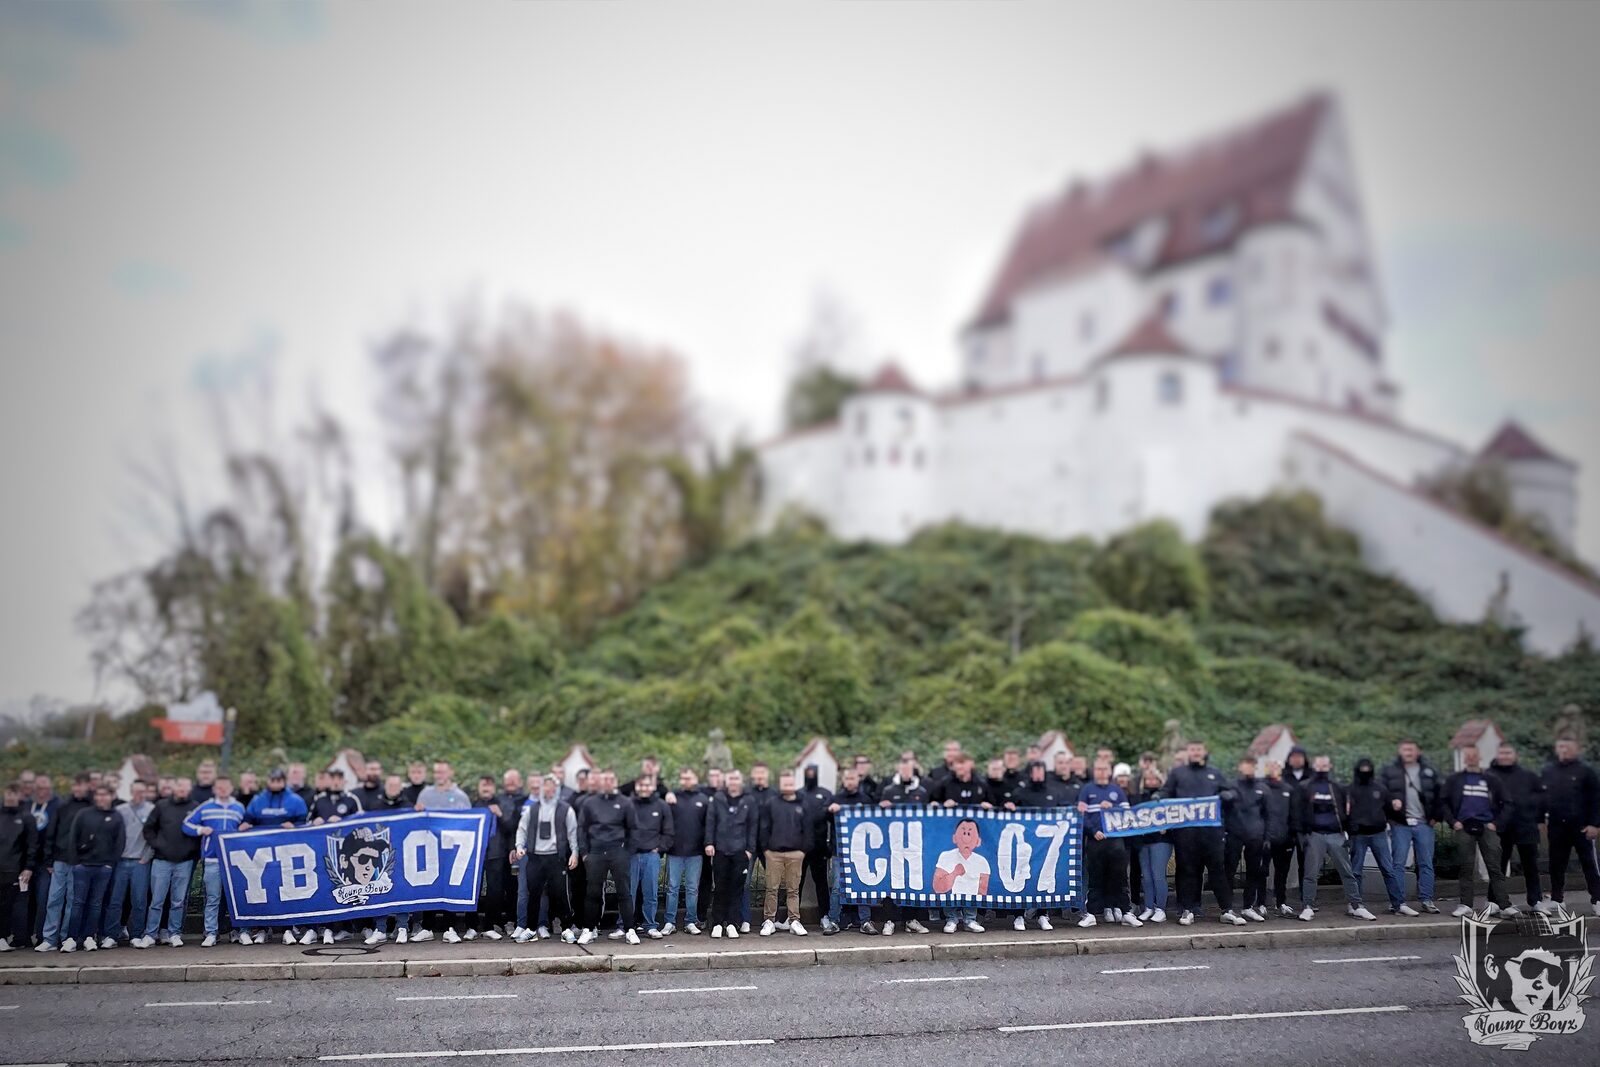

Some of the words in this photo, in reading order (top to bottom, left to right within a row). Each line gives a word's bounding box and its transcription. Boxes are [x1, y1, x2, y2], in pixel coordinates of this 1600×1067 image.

[1104, 801, 1217, 833] NASCENTI
[229, 843, 318, 904] YB
[402, 830, 475, 886] 07
[850, 820, 924, 891] CH
[997, 820, 1070, 893] 07
